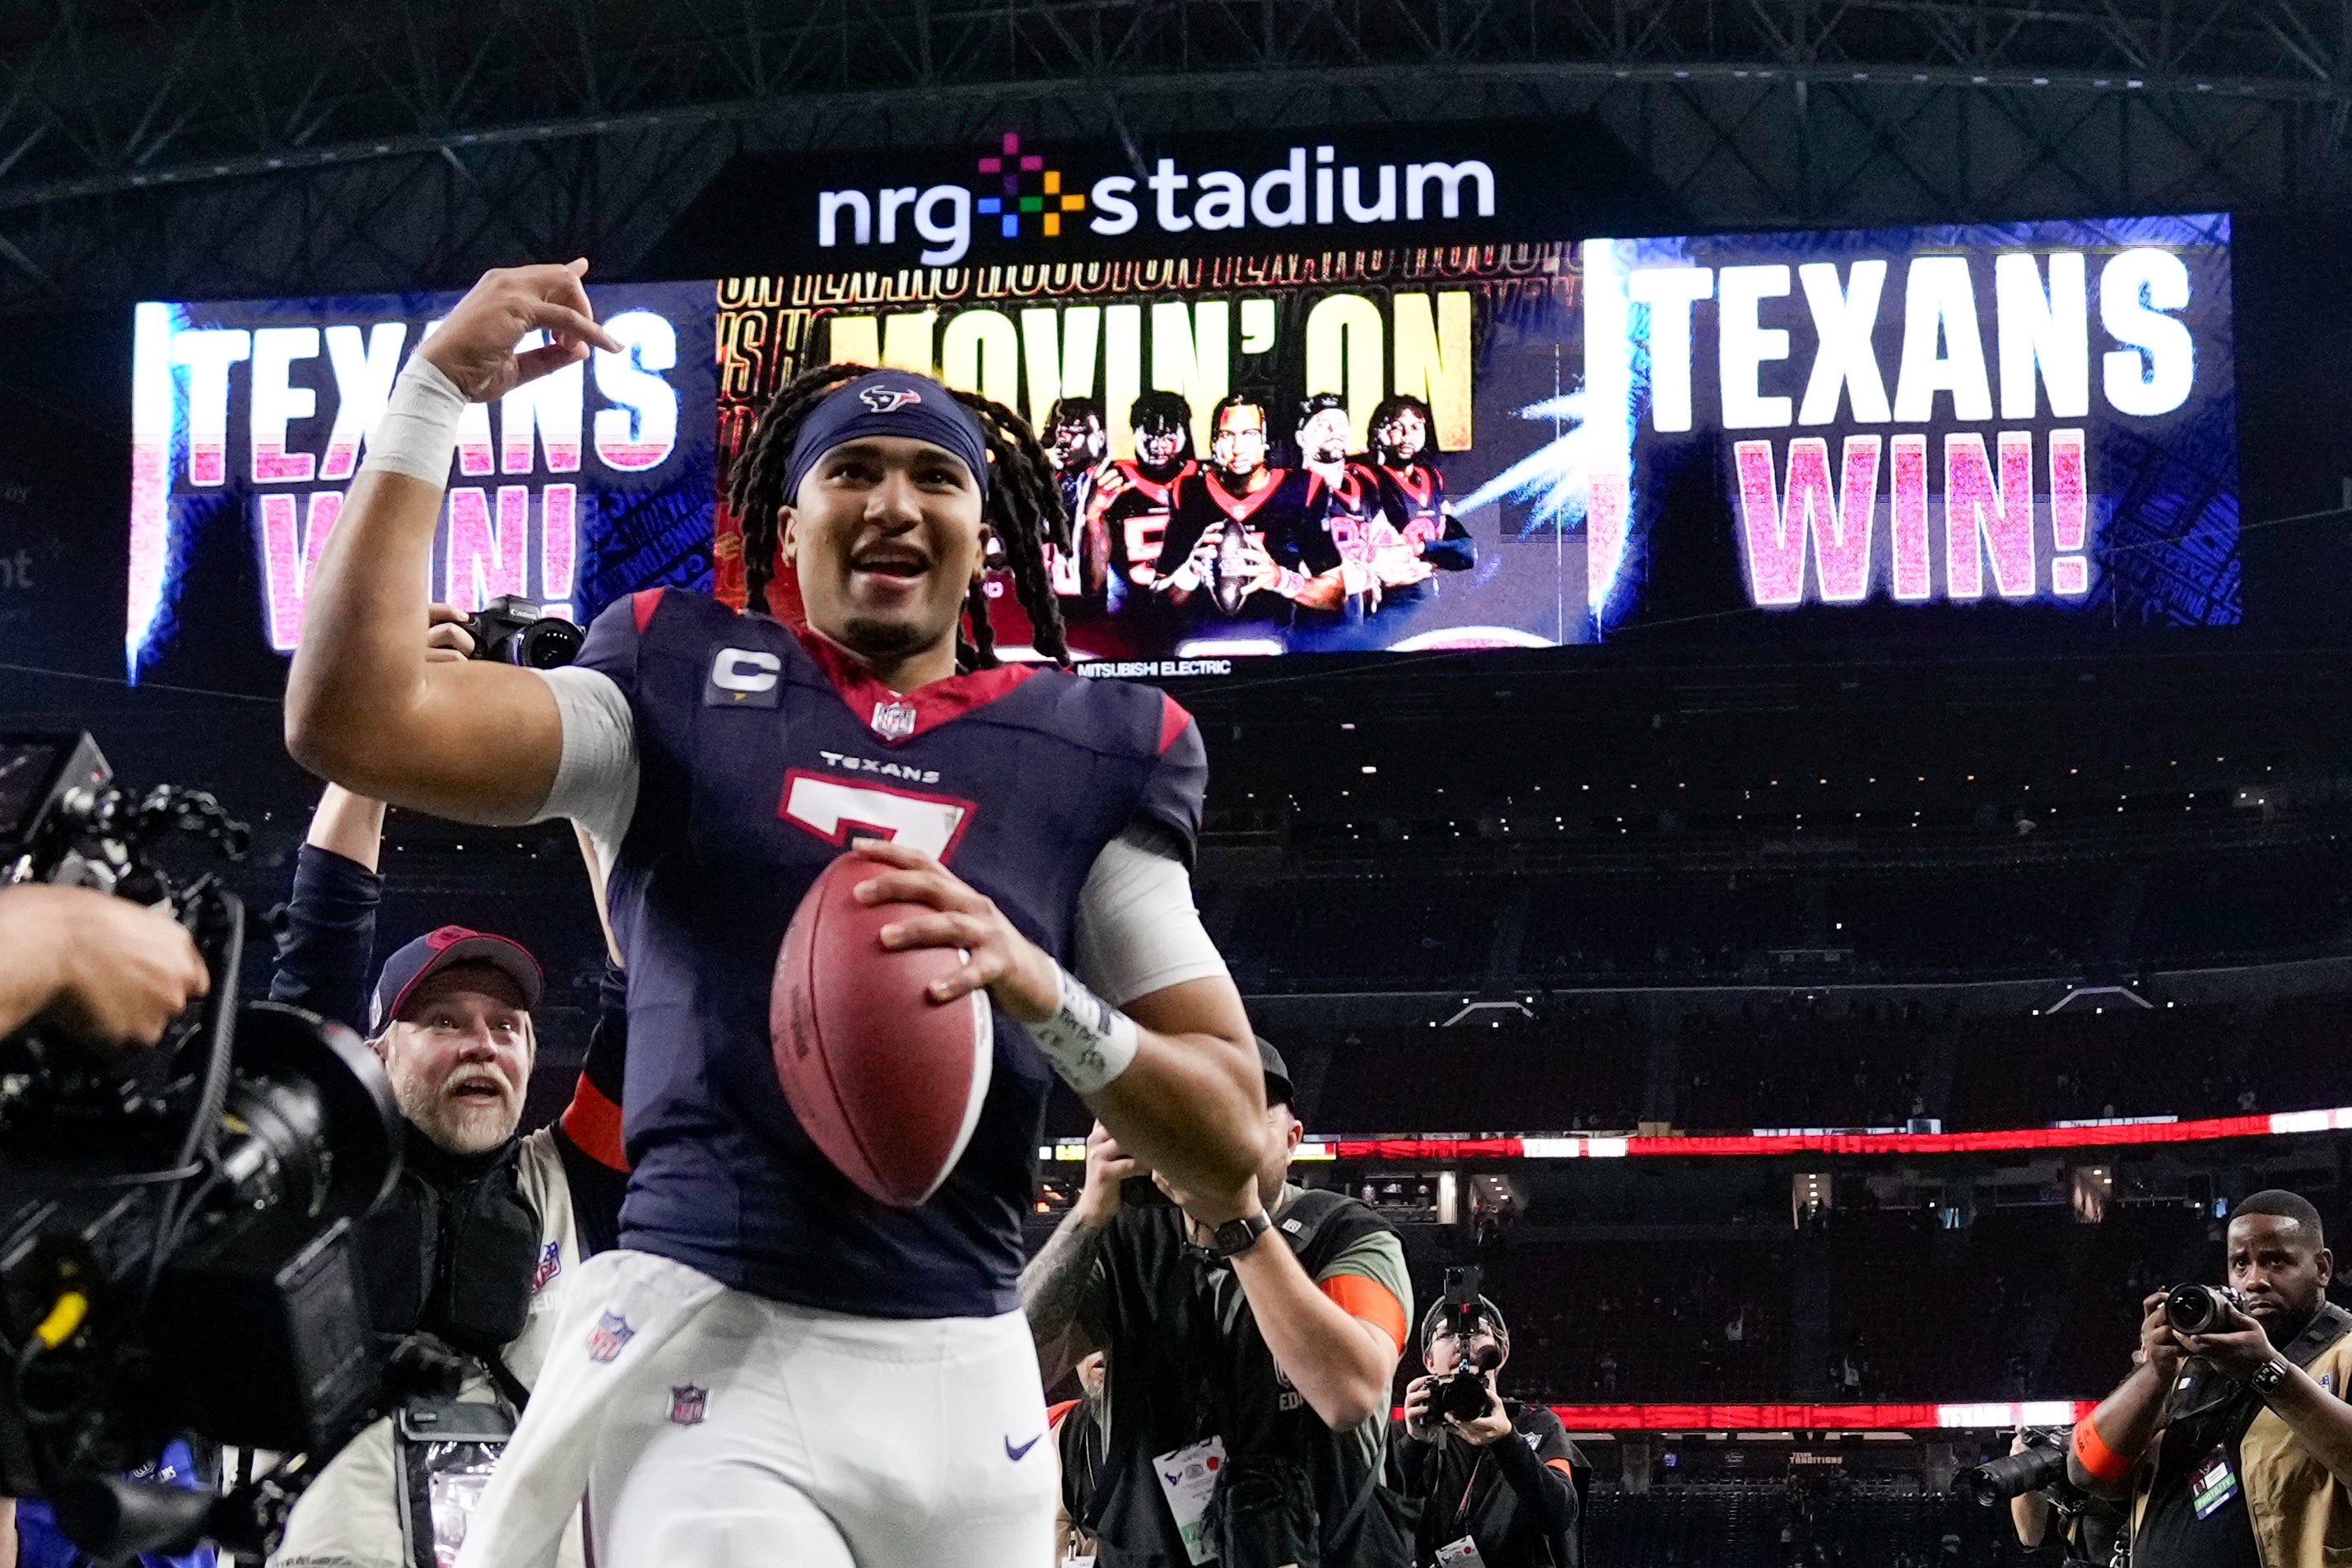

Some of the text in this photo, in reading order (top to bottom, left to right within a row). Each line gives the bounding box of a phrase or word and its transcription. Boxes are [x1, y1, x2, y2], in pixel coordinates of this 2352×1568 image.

[818, 145, 1496, 266] nrg stadium
[170, 310, 679, 488] TEXNS
[1306, 291, 1474, 453] ON
[1627, 245, 2197, 434] TEXANS
[261, 482, 576, 652] WN!
[1734, 427, 2089, 607] WIN!
[711, 647, 781, 692] C
[1077, 659, 1232, 678] MITSUBISHI ELECTRIC
[820, 750, 940, 784] TEXANS
